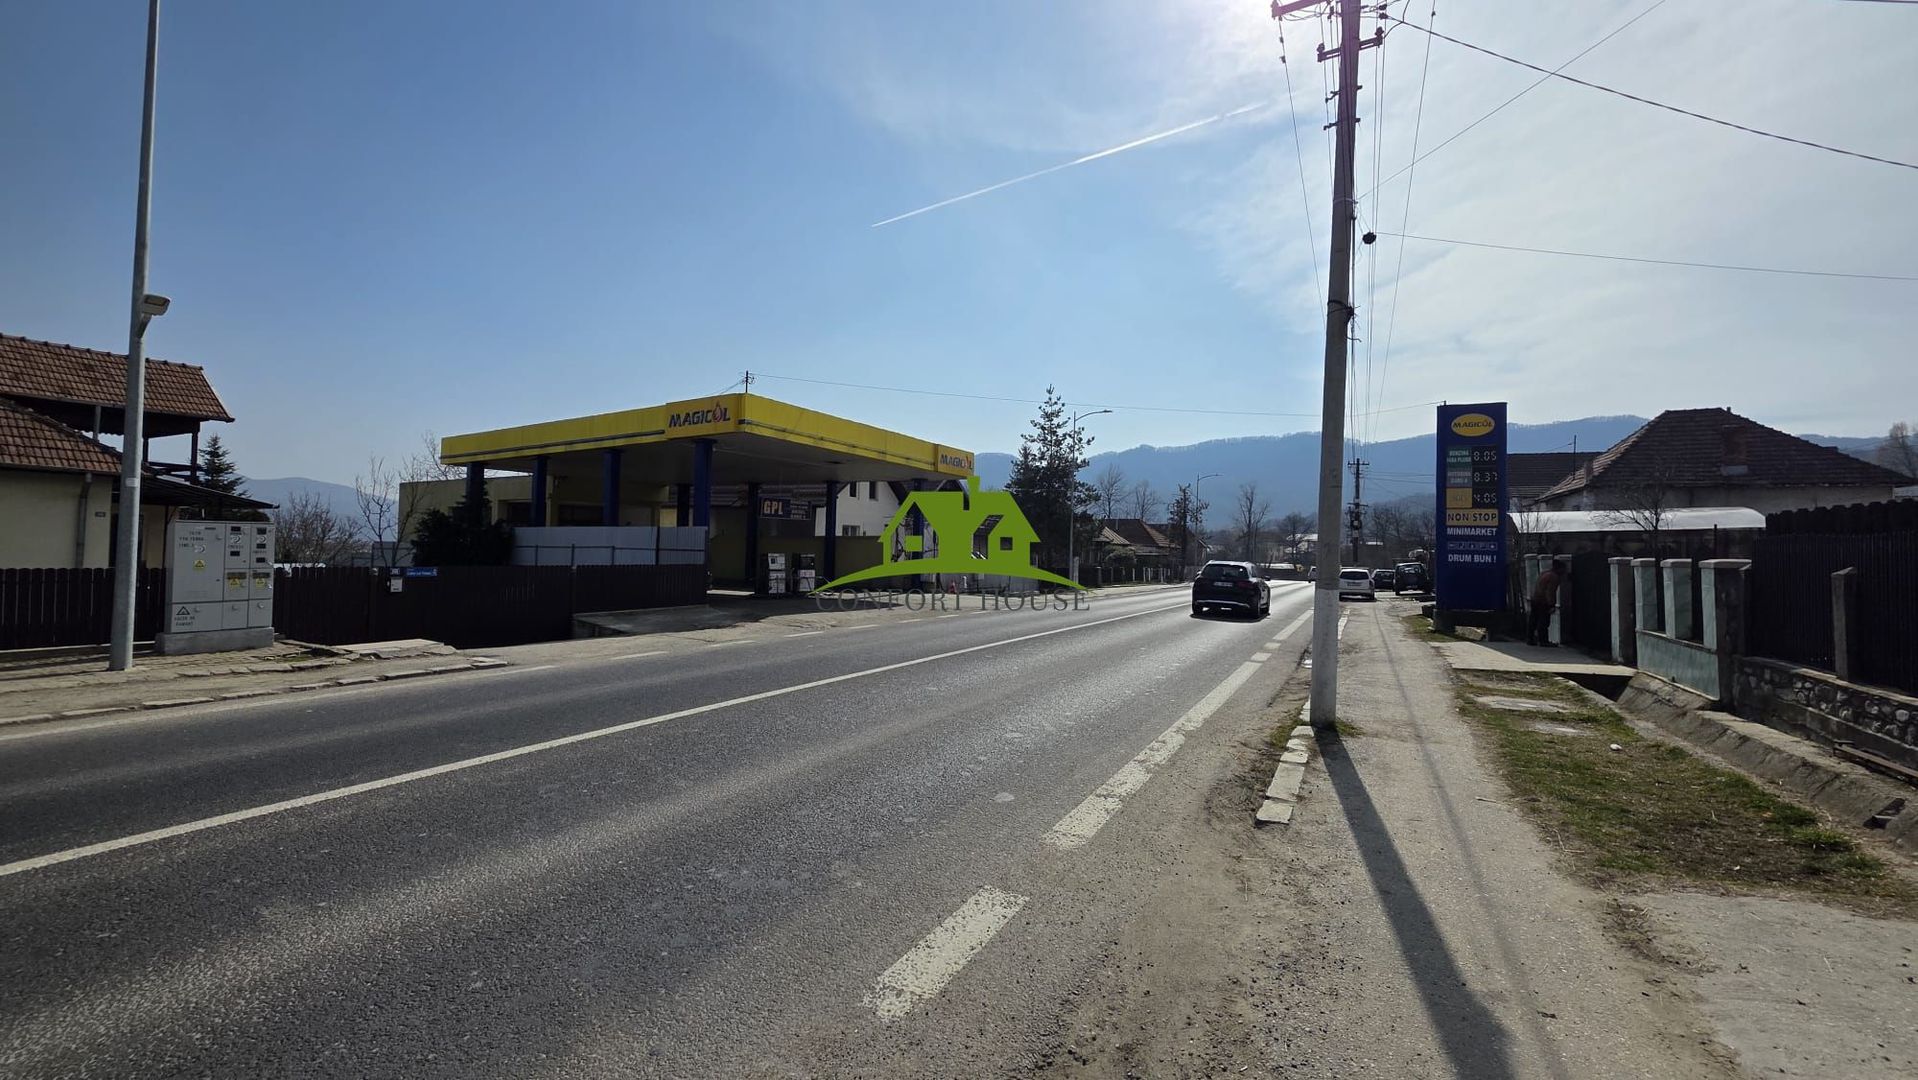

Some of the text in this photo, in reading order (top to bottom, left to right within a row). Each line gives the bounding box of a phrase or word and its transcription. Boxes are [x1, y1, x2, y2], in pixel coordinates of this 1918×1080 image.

[1473, 450, 1497, 461] 8.05
[1473, 472, 1498, 482] 8.37
[1473, 492, 1497, 503] 4.05
[763, 501, 784, 515] GPL
[1447, 512, 1497, 521] NON STOP
[1446, 527, 1497, 536] MINIMARKET
[1448, 554, 1472, 562] DRUM
[1473, 554, 1492, 562] BUN
